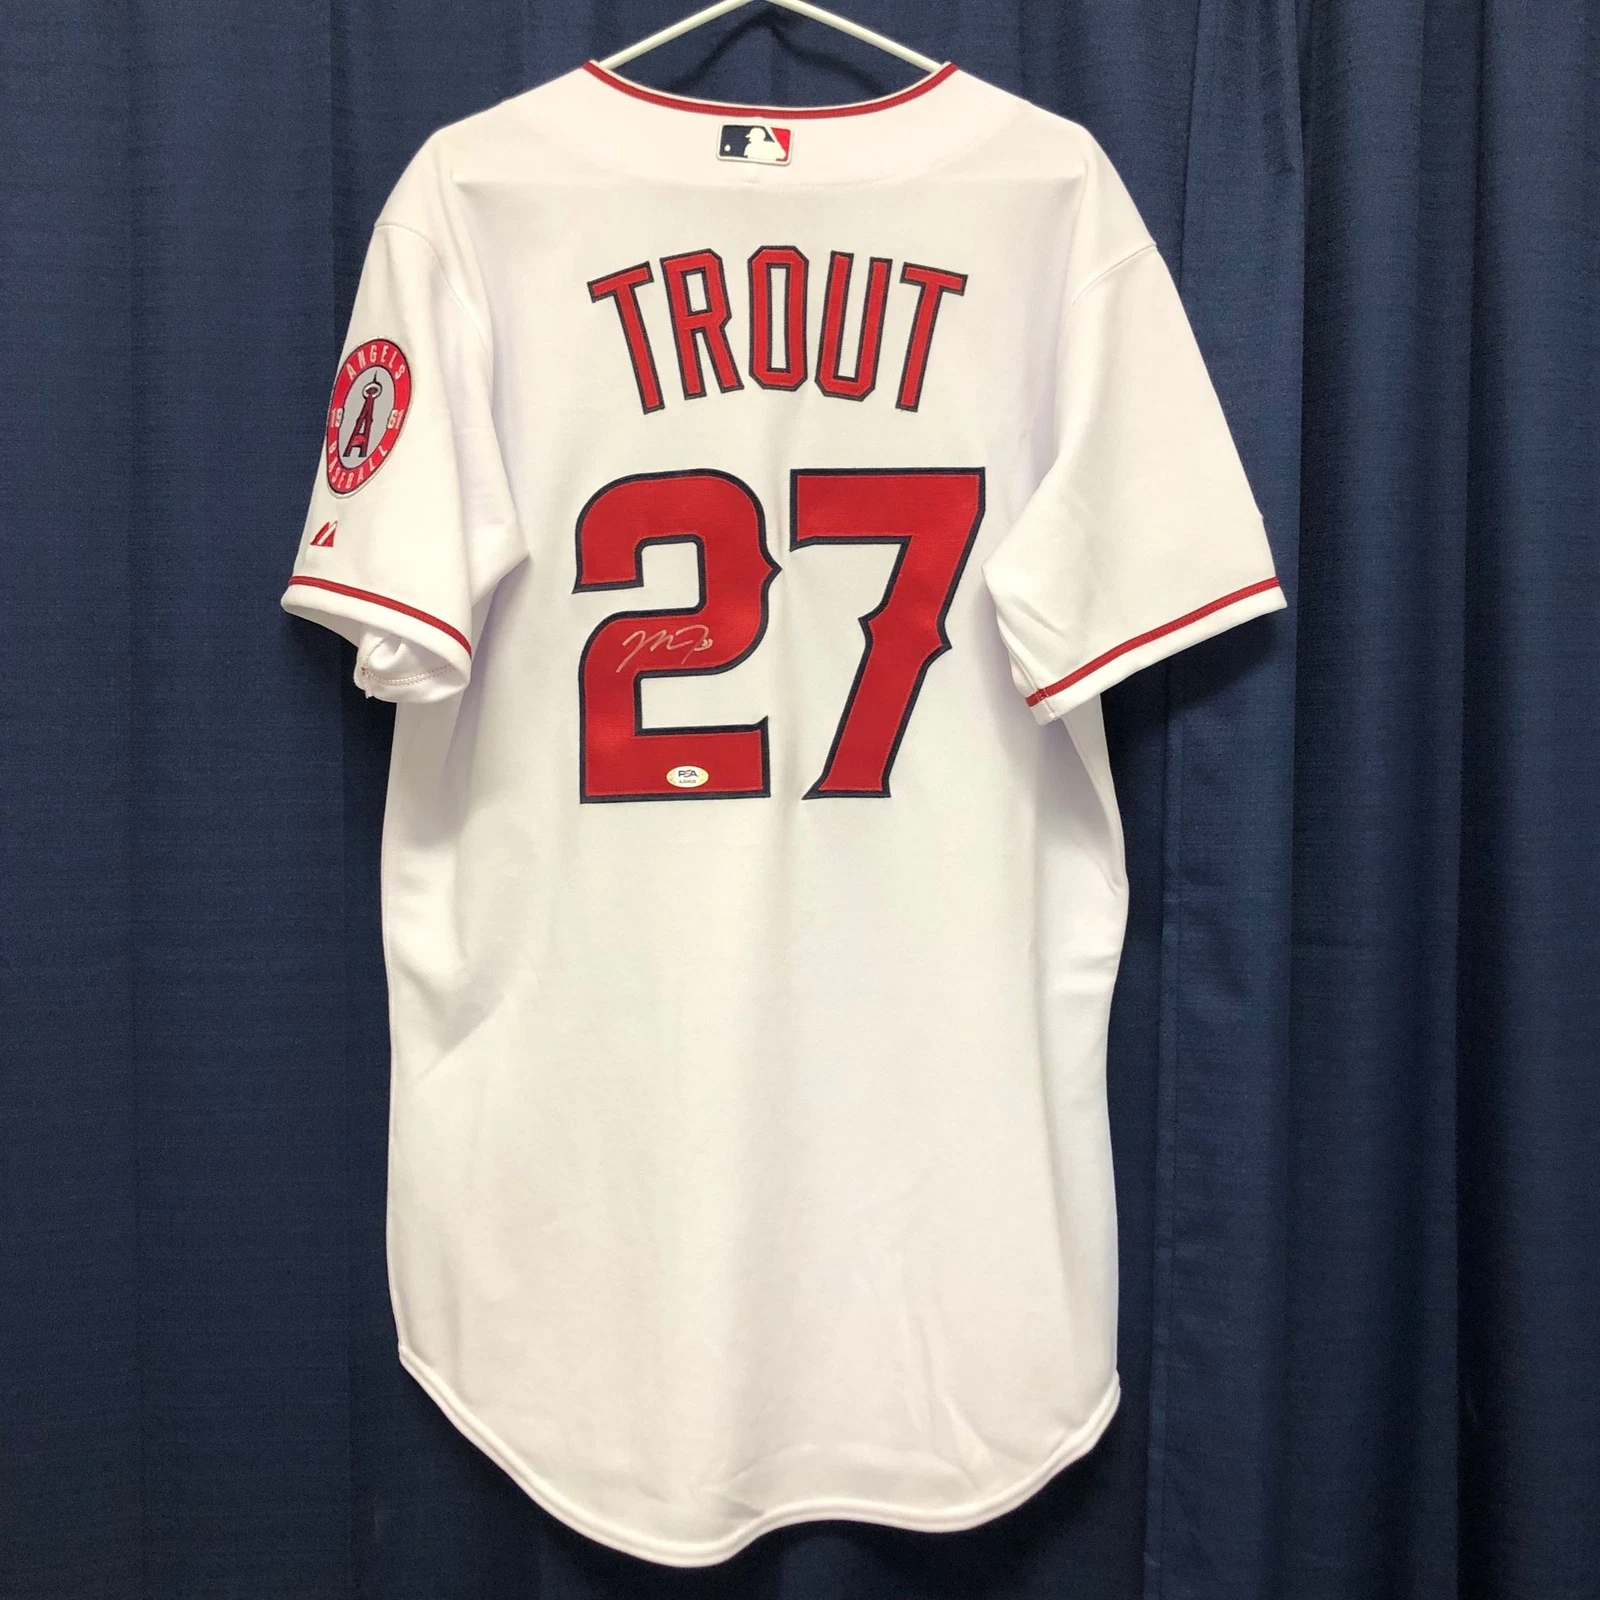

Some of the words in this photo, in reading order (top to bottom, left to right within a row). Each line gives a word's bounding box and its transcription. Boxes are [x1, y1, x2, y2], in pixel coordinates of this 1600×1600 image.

[586, 245, 969, 415] TROUT
[347, 345, 406, 380] ANGELS
[330, 407, 344, 428] 19
[386, 408, 405, 430] 61
[328, 442, 388, 489] BASEBALL
[572, 467, 986, 804] 27
[678, 769, 699, 778] PSA
